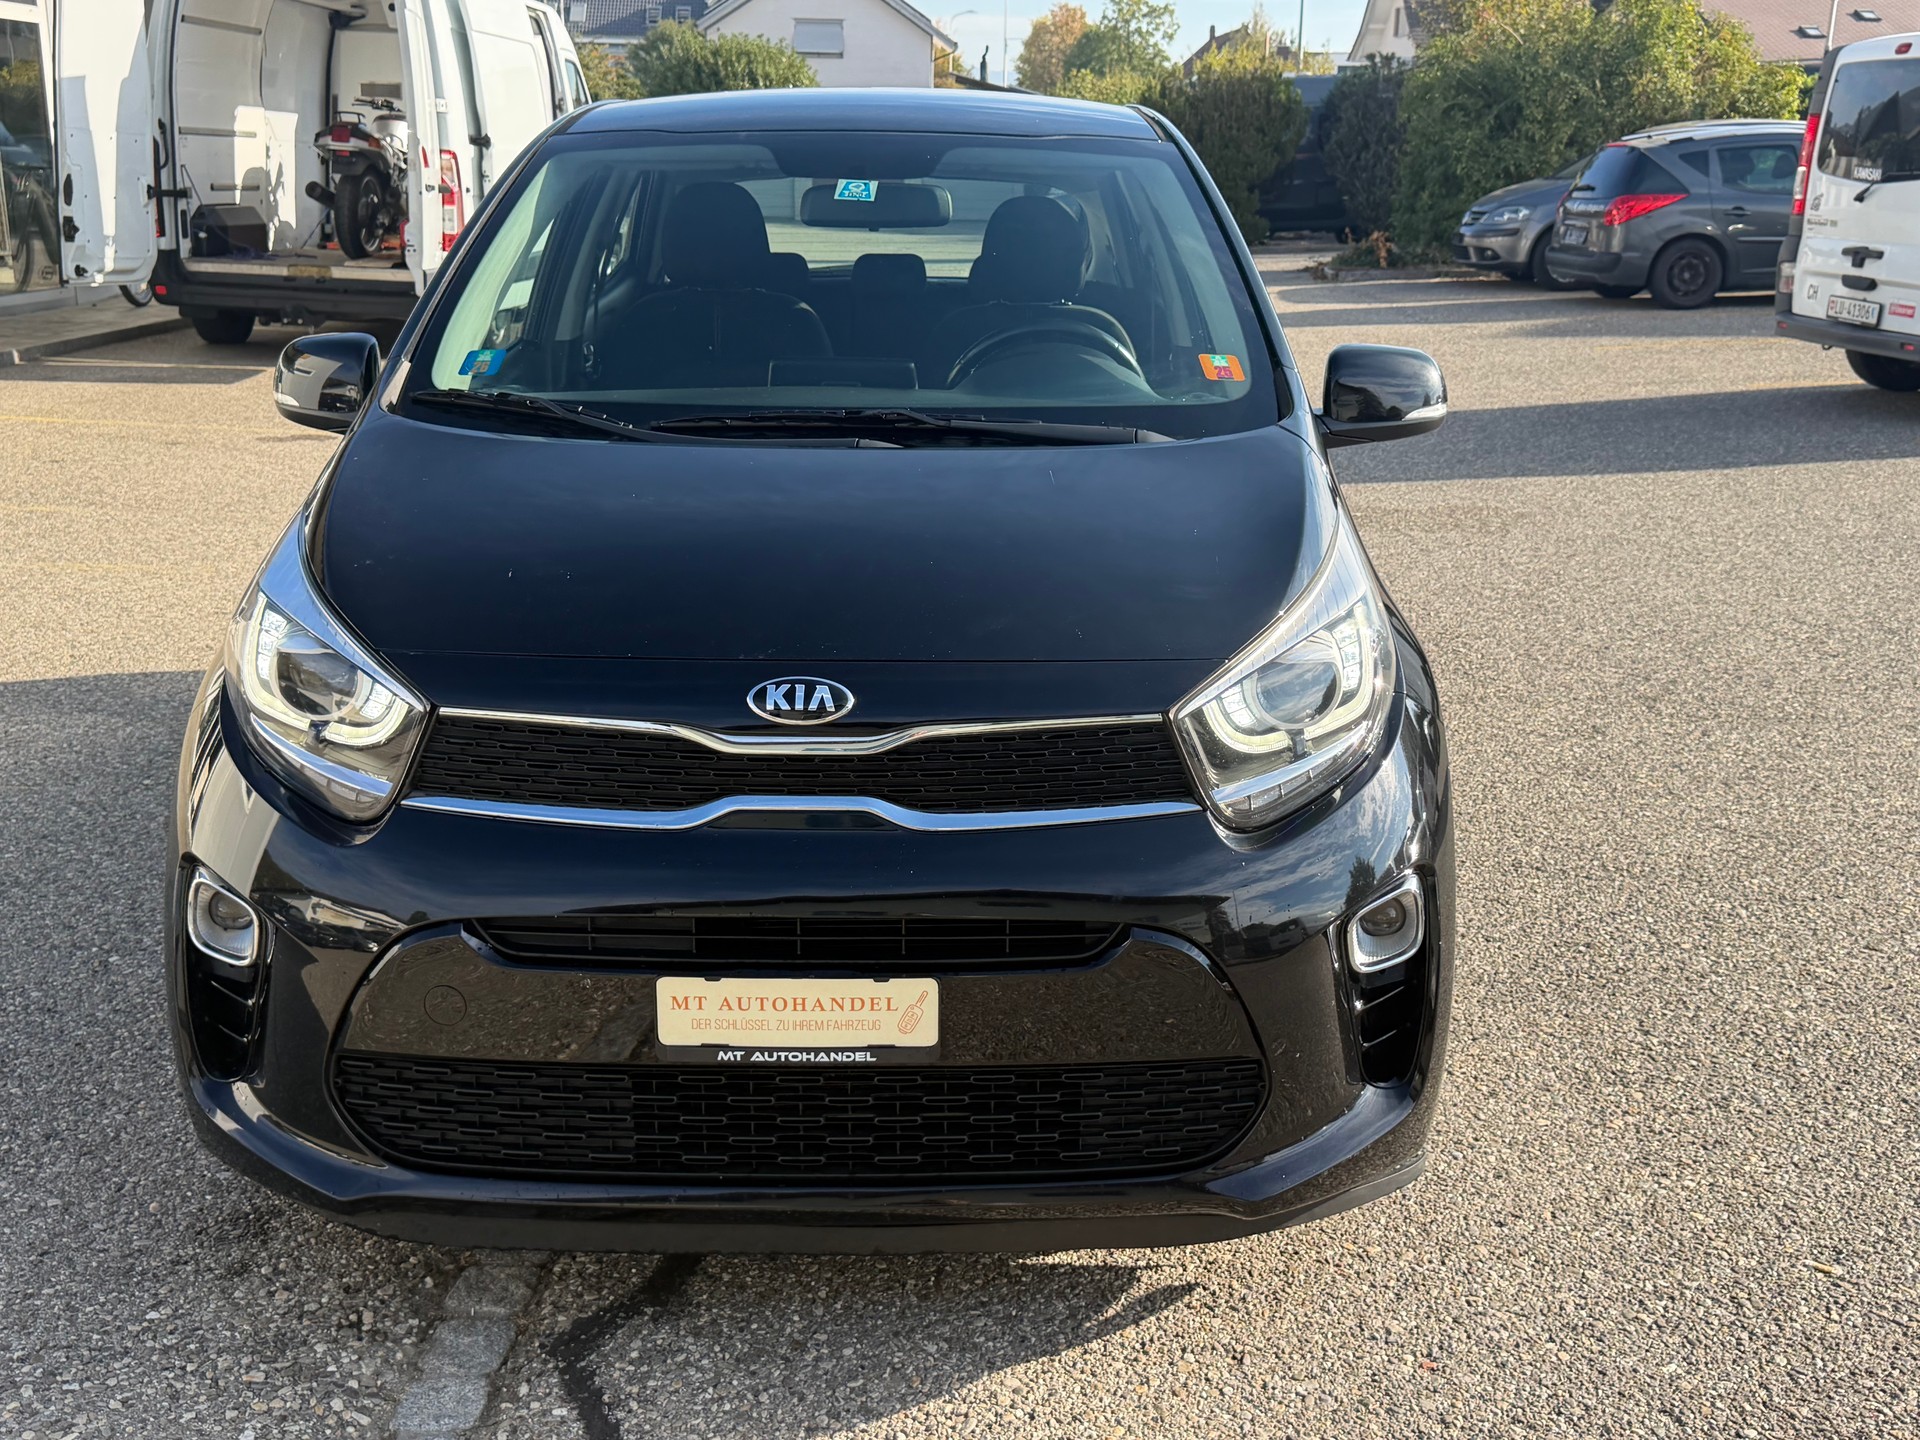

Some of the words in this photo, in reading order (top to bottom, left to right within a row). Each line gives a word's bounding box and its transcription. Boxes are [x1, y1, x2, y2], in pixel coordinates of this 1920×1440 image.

[1807, 284, 1819, 300] CH
[766, 684, 836, 712] KIA
[670, 995, 708, 1010] MT
[719, 996, 899, 1012] AUTOHANDEL
[691, 1018, 712, 1030] DER
[714, 1017, 773, 1031] SCHLÜSSEL
[775, 1020, 790, 1031] ZU
[792, 1020, 825, 1031] IHREM
[827, 1020, 881, 1031] FAHRZEUG
[717, 1051, 745, 1061] MT
[750, 1051, 877, 1062] AUTOHANDEL
